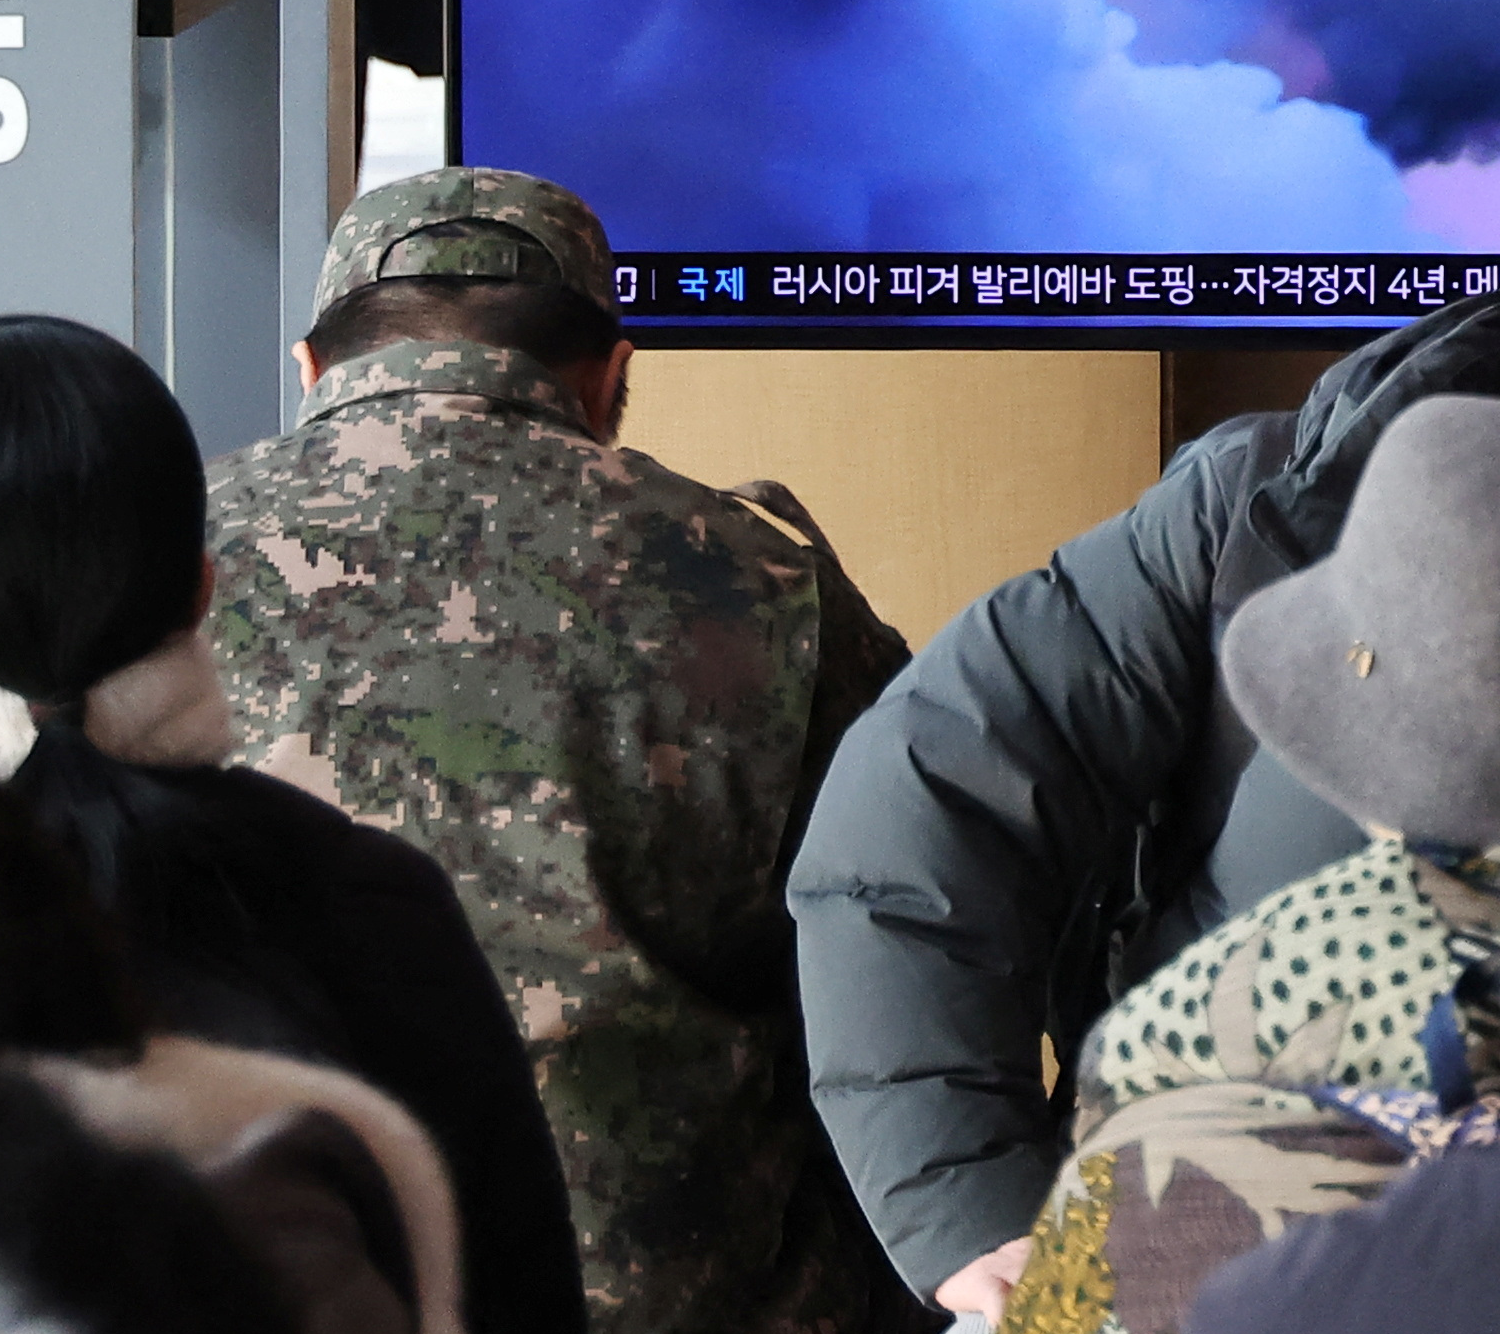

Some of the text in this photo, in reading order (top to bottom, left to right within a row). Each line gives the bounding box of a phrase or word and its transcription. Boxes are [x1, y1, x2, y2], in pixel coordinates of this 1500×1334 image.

[678, 266, 744, 301] 국제
[773, 264, 880, 304] 러시아
[889, 264, 958, 304] 피겨
[972, 264, 1116, 304] 발리예바
